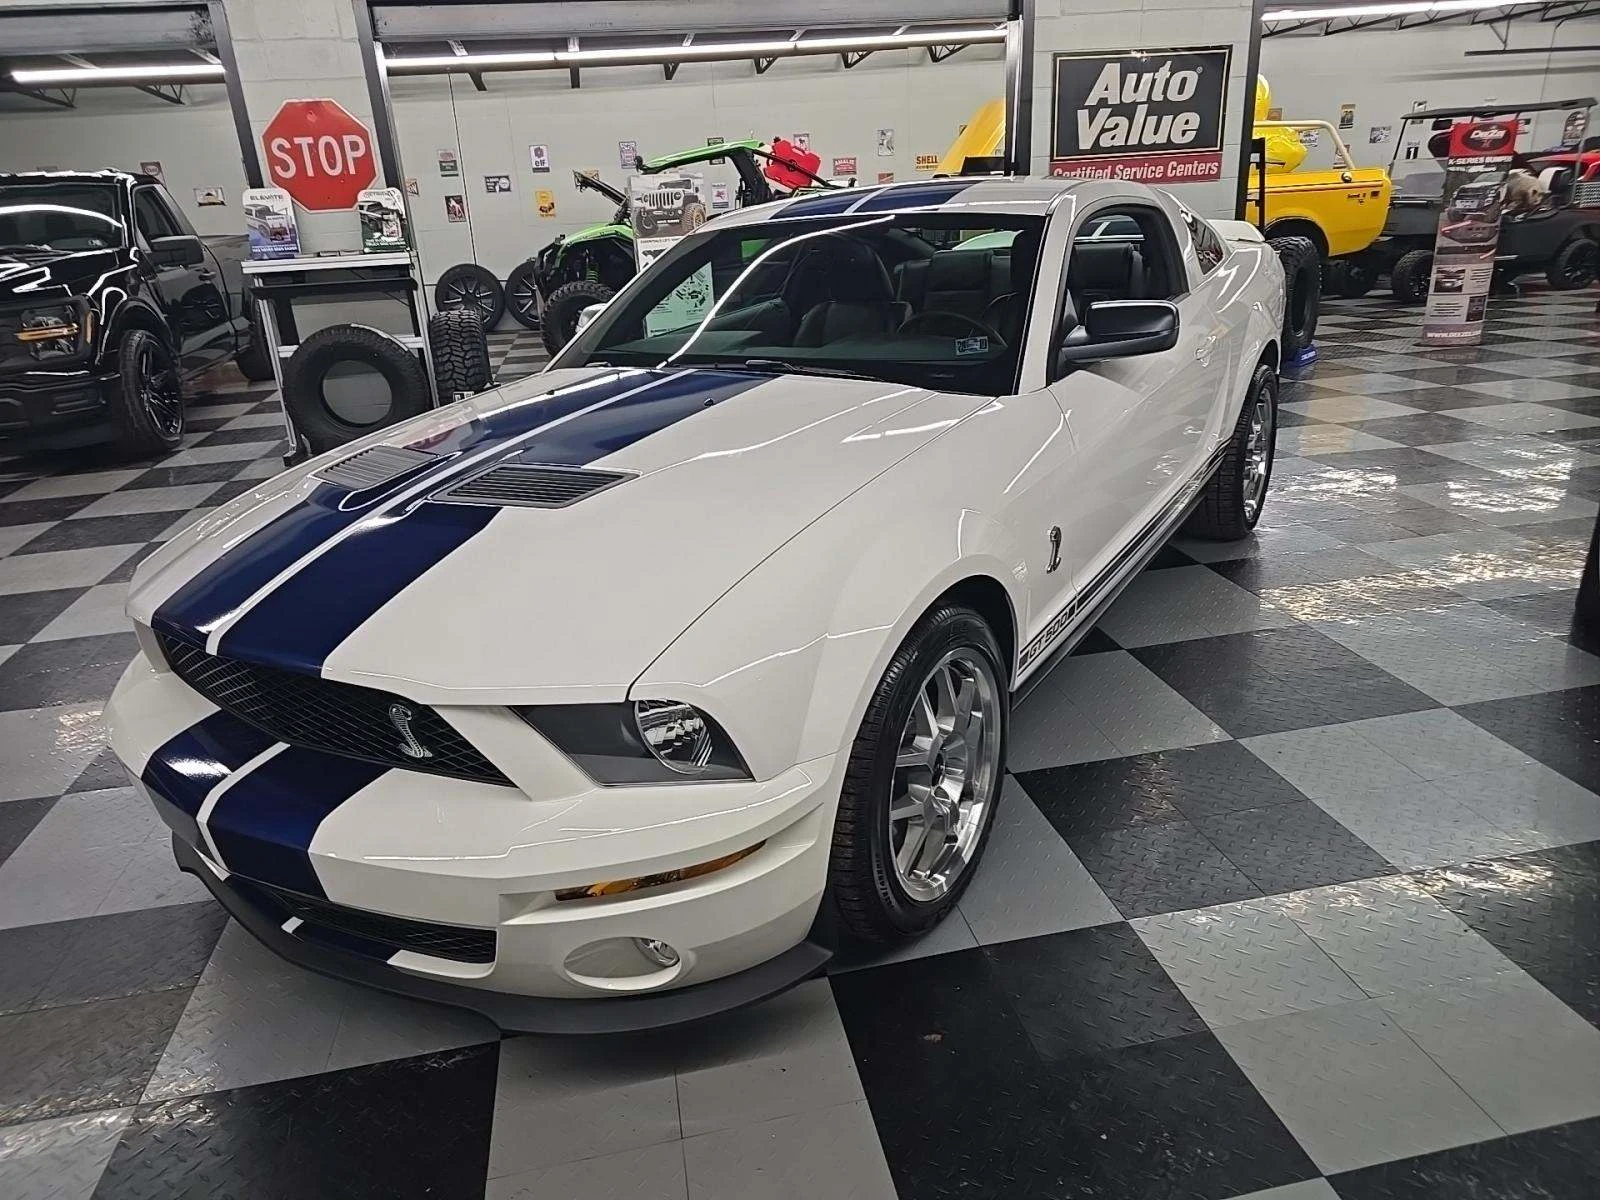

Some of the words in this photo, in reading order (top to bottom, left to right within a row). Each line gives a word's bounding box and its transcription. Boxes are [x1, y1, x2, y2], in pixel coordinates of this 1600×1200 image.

[1084, 61, 1199, 106] Auto
[1077, 104, 1201, 150] Value
[271, 135, 365, 179] STOP
[916, 155, 938, 165] SHELL
[1114, 162, 1164, 180] Service
[1167, 160, 1219, 177] Centers
[1029, 634, 1046, 660] GT
[1045, 611, 1068, 643] 500
